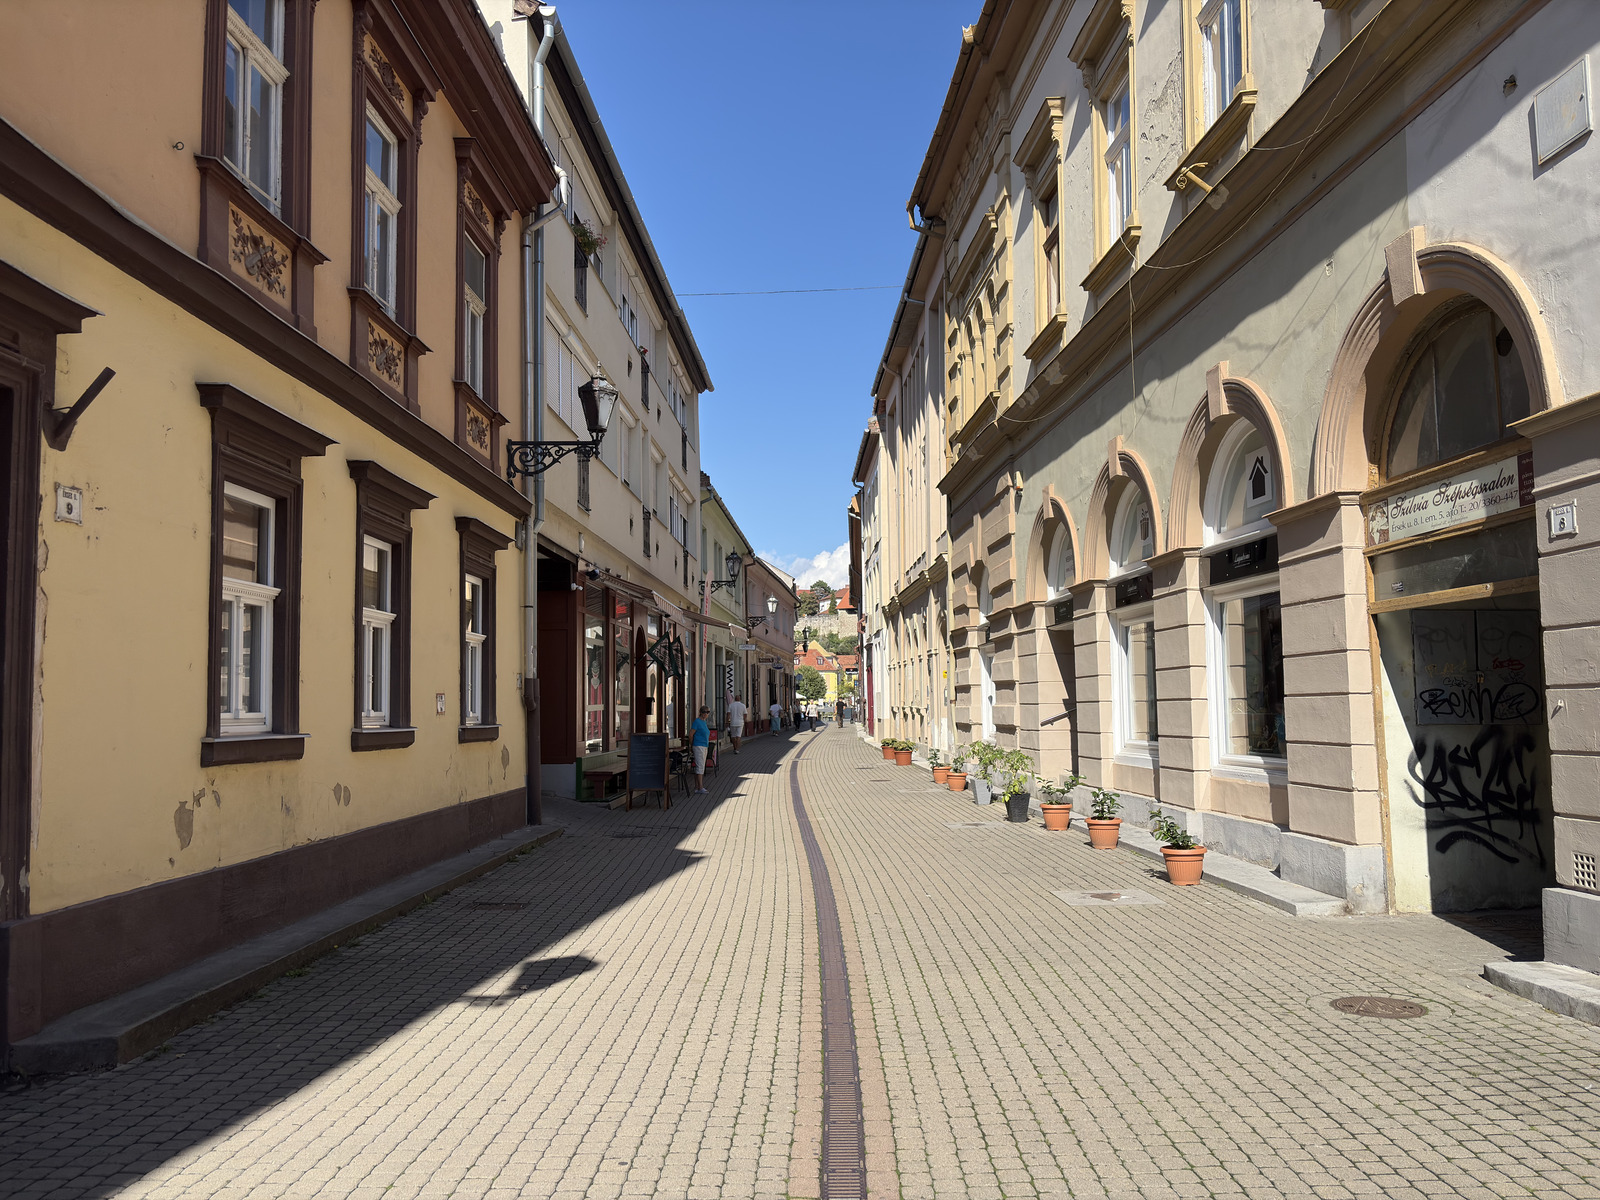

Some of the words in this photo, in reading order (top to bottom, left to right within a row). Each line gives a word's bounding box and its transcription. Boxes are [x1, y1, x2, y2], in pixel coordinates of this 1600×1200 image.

[1391, 495, 1429, 519] Szilvia
[1433, 468, 1515, 509] Szépségszalon
[66, 502, 73, 515] 9
[1392, 521, 1406, 532] Érsek
[1414, 518, 1419, 526] 8.
[1425, 514, 1437, 523] em.
[1439, 511, 1445, 520] 5.
[1468, 490, 1518, 511] 20/3360-447
[1559, 517, 1566, 531] 8
